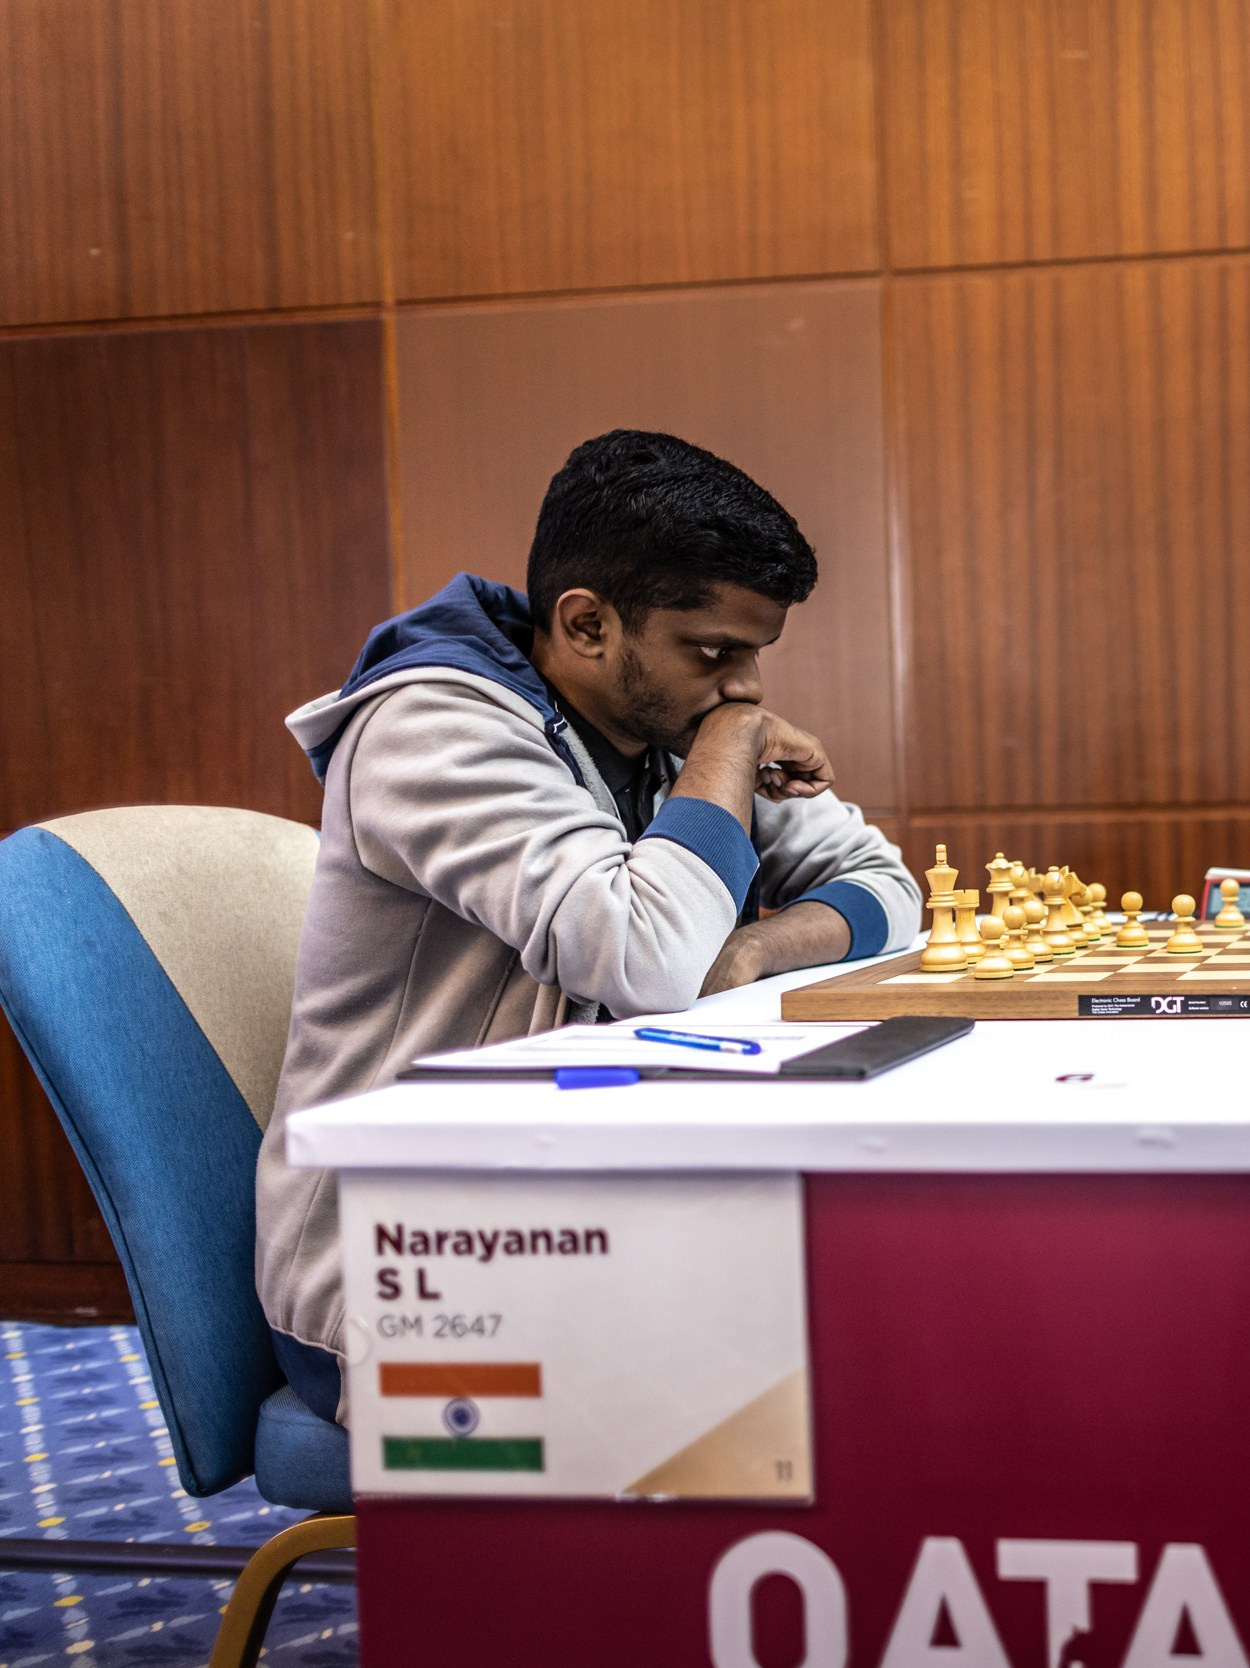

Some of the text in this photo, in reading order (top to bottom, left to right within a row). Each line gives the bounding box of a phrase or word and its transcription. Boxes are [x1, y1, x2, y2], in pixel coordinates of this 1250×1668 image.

[1151, 996, 1185, 1014] DGT
[374, 1222, 610, 1262] Narayanan
[376, 1268, 441, 1301] S L
[377, 1313, 502, 1339] GM 2647
[775, 1461, 793, 1482] 11
